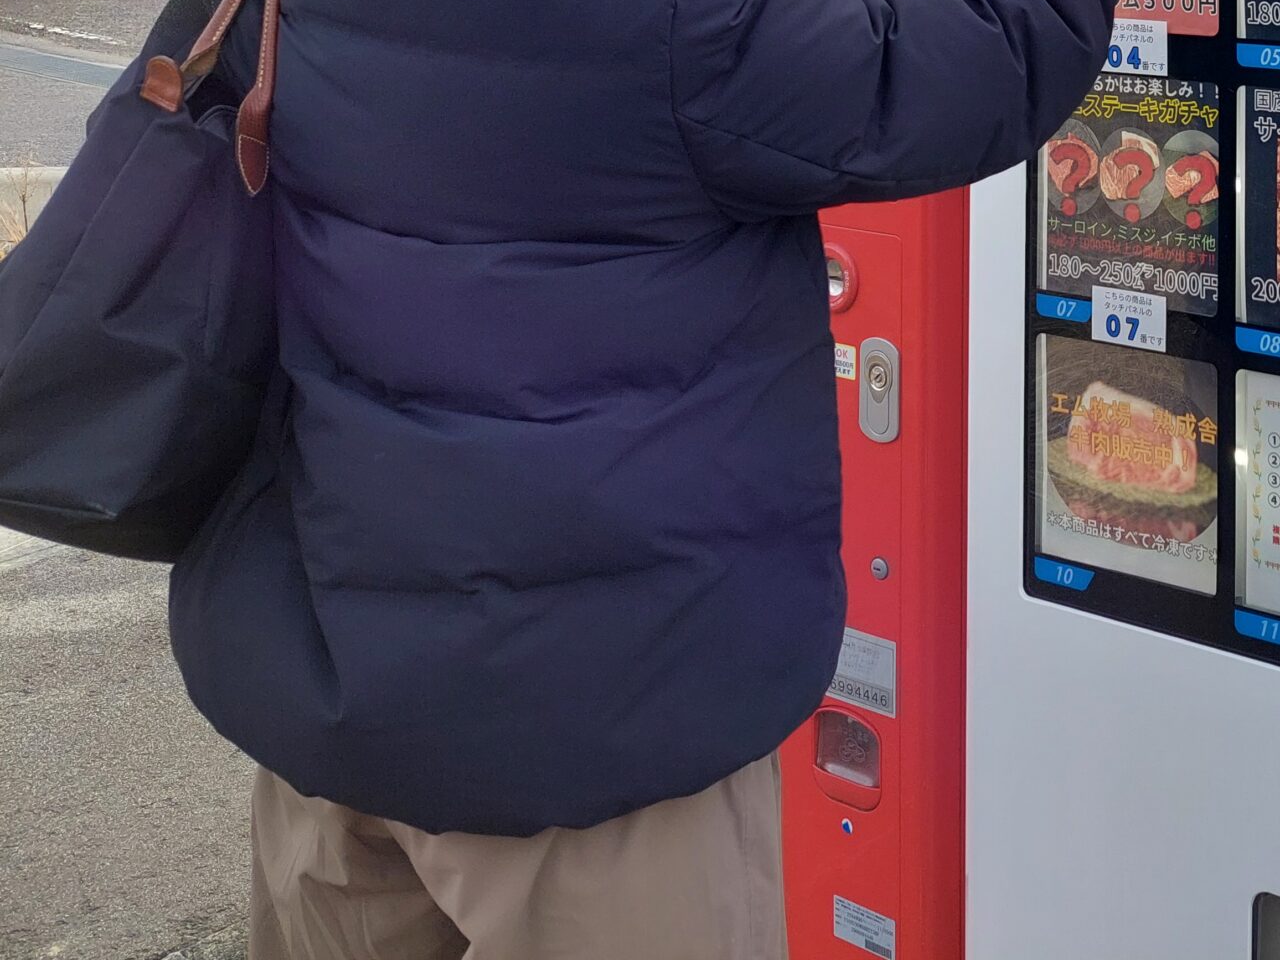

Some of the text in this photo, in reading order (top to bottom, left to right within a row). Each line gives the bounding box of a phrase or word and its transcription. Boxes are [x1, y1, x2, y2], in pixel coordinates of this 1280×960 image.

[1113, 23, 1153, 33] ちらの商品は
[1112, 34, 1154, 44] ッチパネルの
[1093, 76, 1219, 100] るかはお楽しみ！！
[1073, 94, 1219, 128] ステーキガチャ
[1104, 291, 1153, 306] こちらの商品は
[1056, 301, 1077, 317] 07
[1104, 301, 1153, 316] タッチパネルの
[836, 348, 848, 359] OK
[1056, 565, 1074, 584] 10
[1260, 619, 1279, 640] 11
